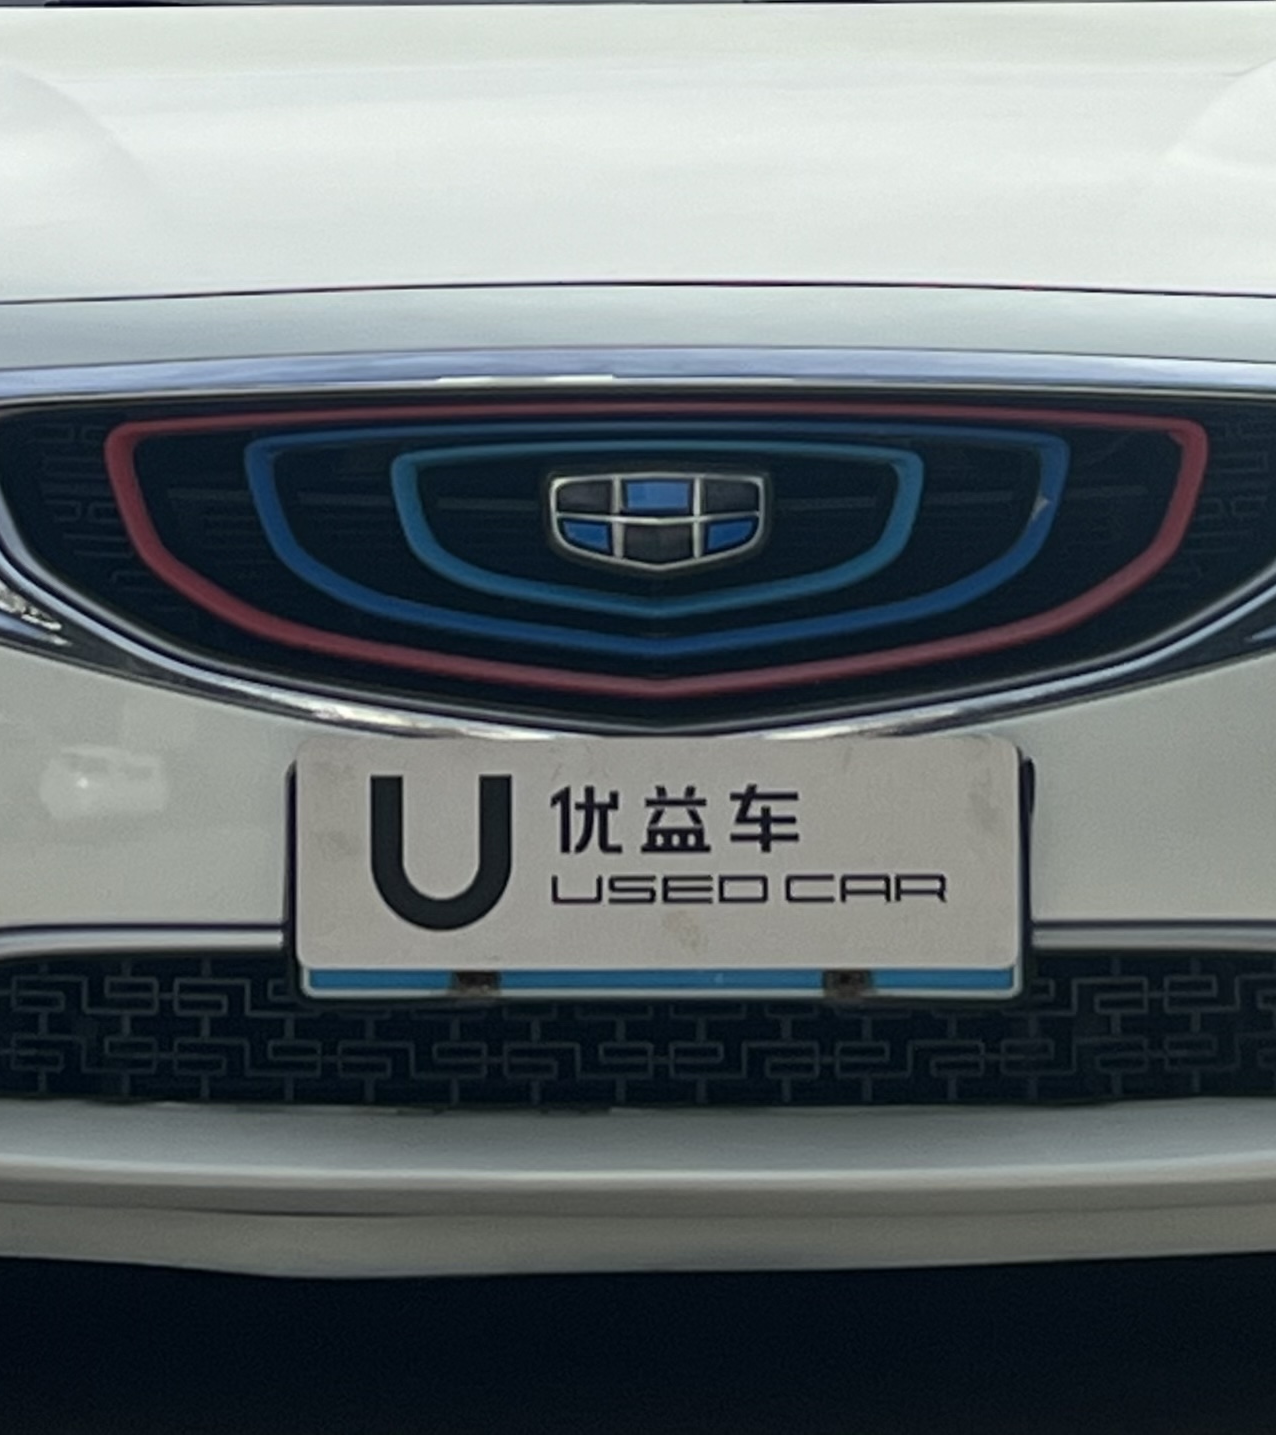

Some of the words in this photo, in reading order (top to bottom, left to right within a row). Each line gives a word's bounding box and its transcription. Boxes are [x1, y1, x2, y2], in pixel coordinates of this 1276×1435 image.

[370, 774, 513, 931] U
[550, 783, 800, 855] 优益车
[551, 874, 770, 905] USED
[784, 873, 947, 904] CAR
